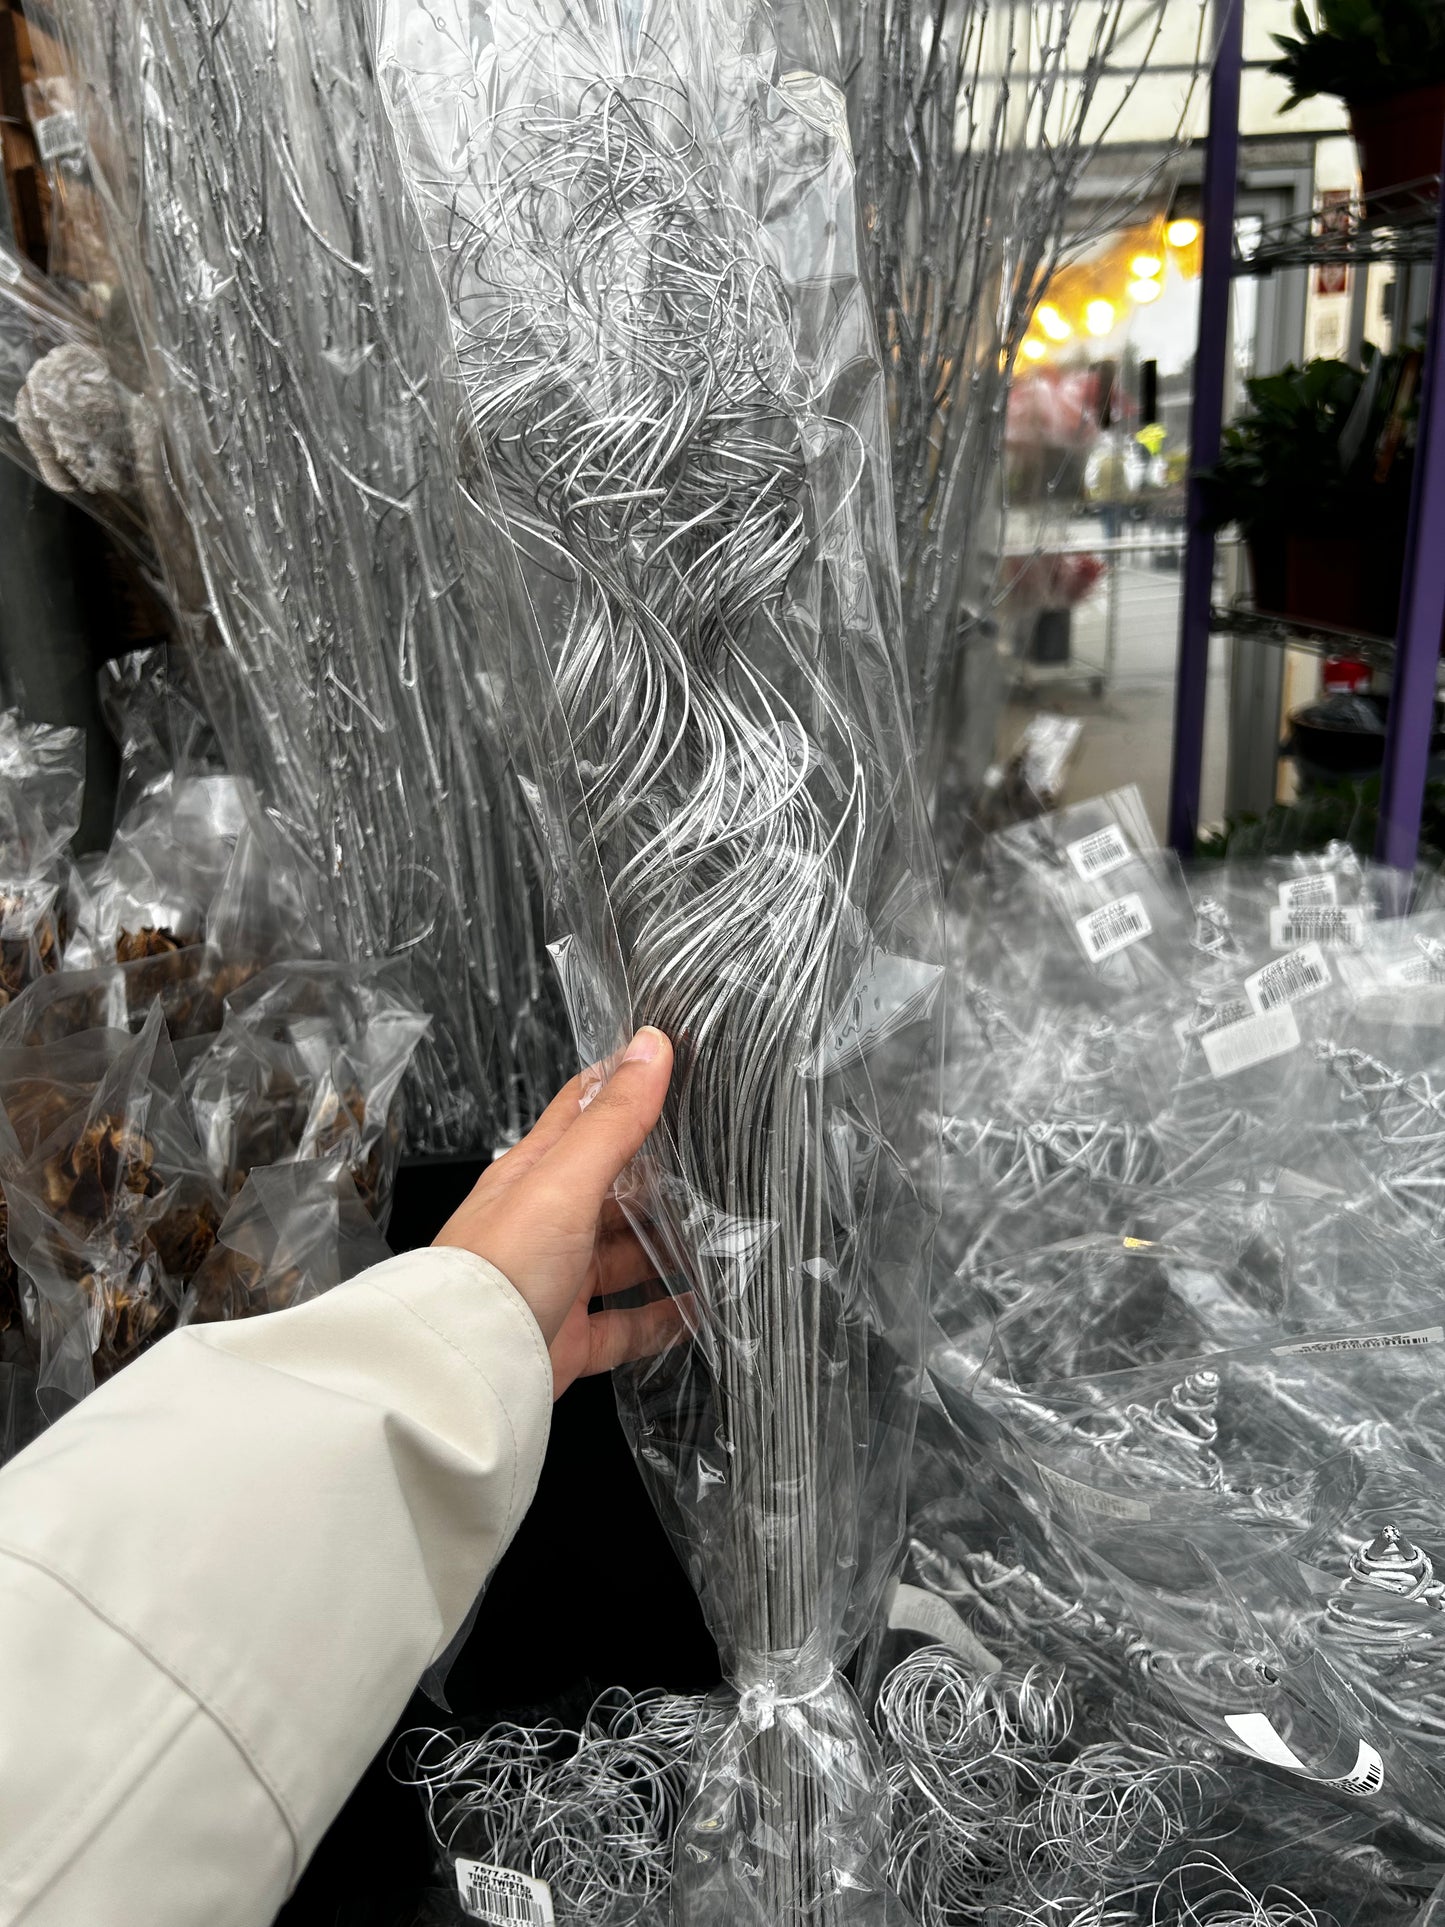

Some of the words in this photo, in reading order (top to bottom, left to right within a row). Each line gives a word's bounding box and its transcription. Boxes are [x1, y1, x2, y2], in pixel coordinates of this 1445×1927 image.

[472, 1880, 507, 1895] METALLIC
[508, 1888, 534, 1901] SILVER
[491, 1877, 532, 1894] TWISTED
